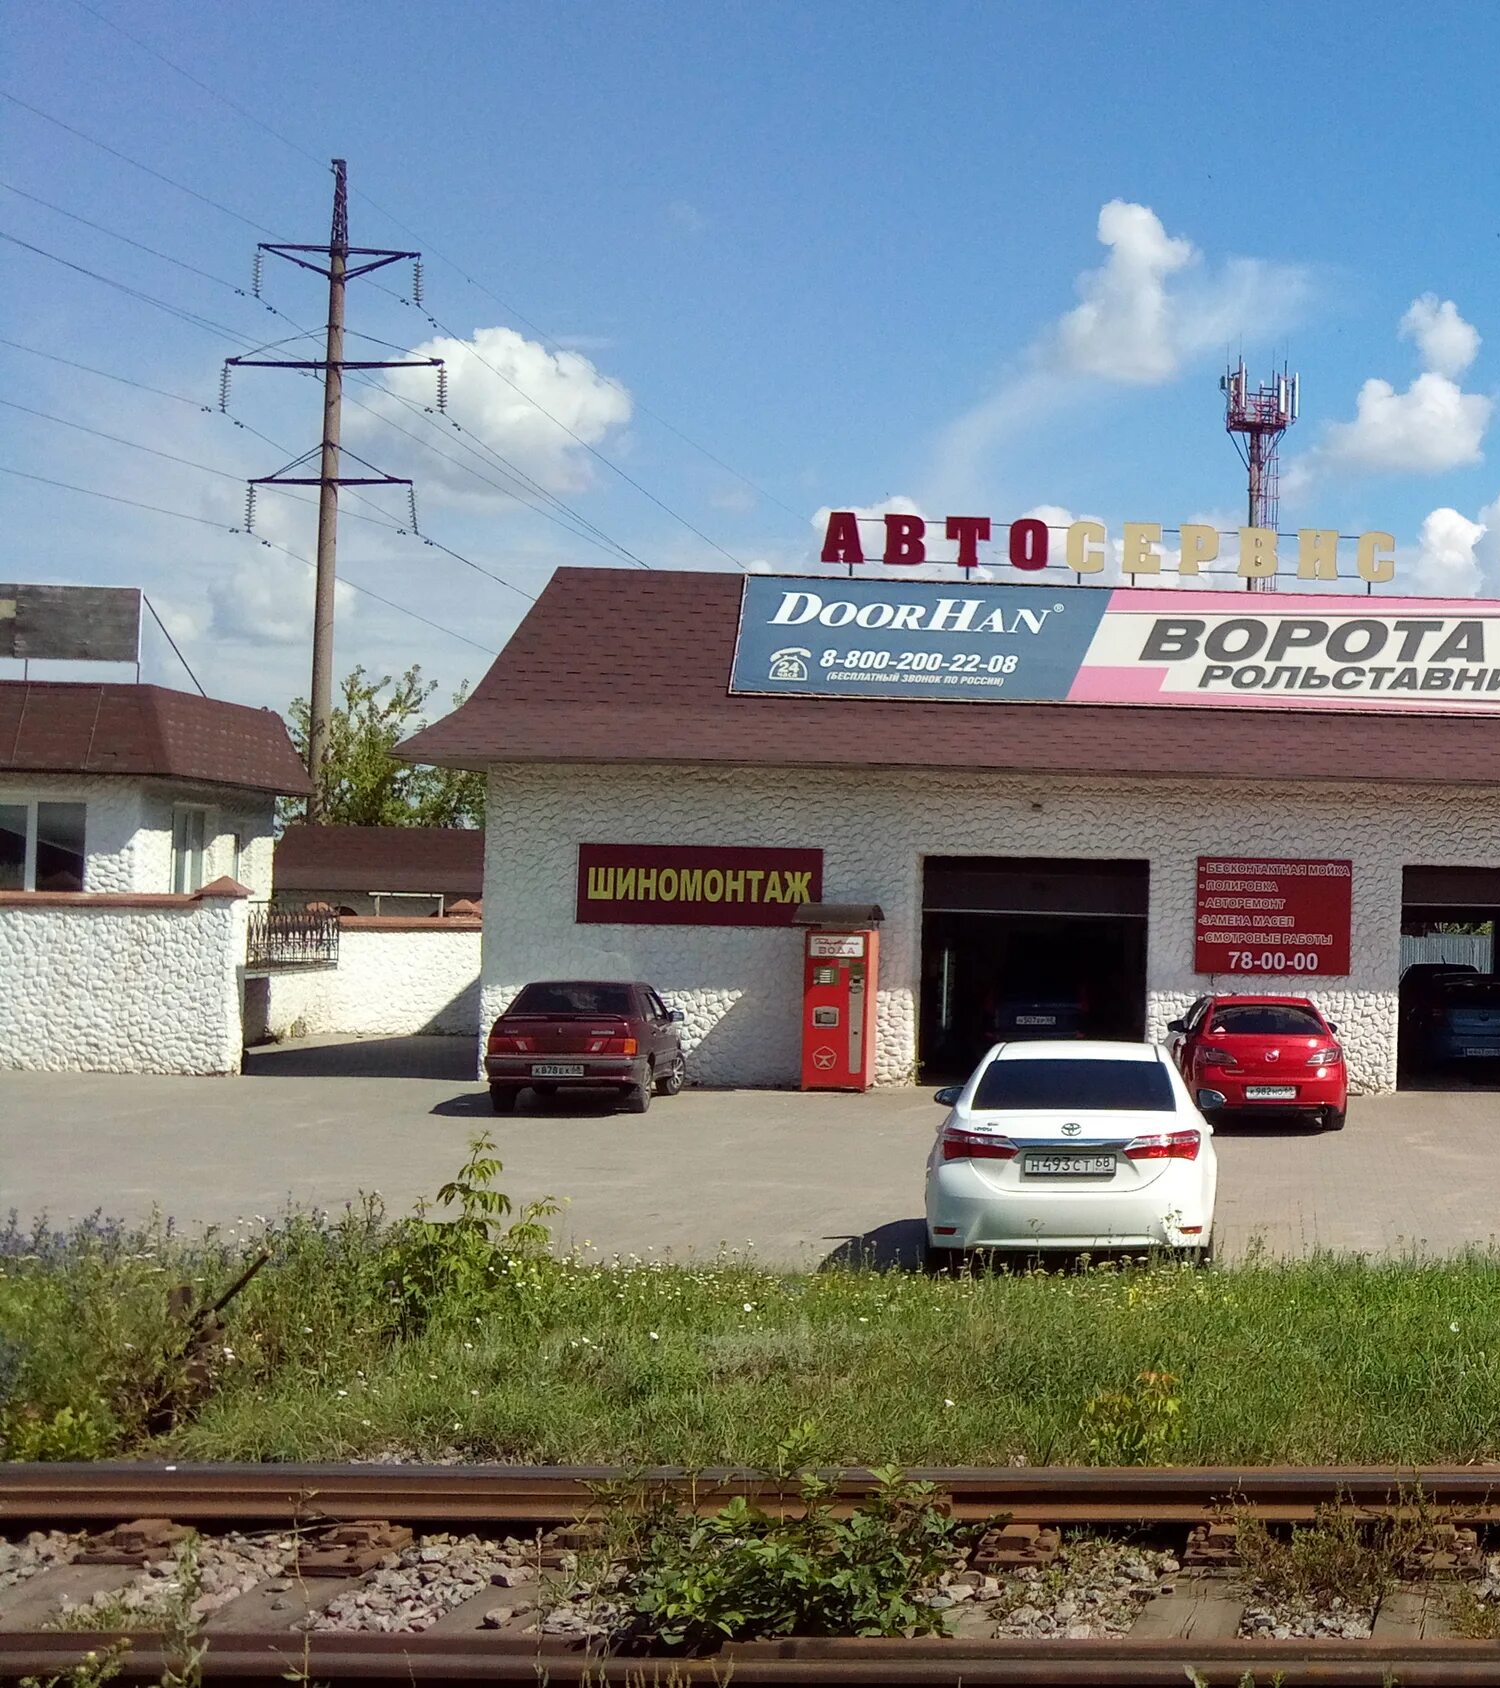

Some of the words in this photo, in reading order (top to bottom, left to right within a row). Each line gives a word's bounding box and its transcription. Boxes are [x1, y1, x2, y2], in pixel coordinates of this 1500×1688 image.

[1138, 618, 1486, 663] ВОРОТА
[778, 661, 800, 673] 24
[819, 649, 1018, 674] 8-800-200-22-08
[826, 671, 899, 683] (БЕСПЛАТНЫЙ
[901, 673, 943, 684] ЗВОНОК
[944, 675, 958, 684] ПО
[959, 676, 1004, 687] РОССИИ)
[1206, 862, 1307, 876] БЕСКОНТАКТНАЯ
[1308, 864, 1350, 877] МОЙКА
[587, 867, 812, 904] ШИНОМОНТАЖ
[1206, 880, 1279, 892] ПОЛИРОВКА
[1204, 897, 1286, 910] АВТОРЕМОНТ
[1252, 915, 1295, 927] МАСЕЛ
[1282, 933, 1333, 946] РАБОТЫ
[818, 946, 855, 954] ВОДА
[1228, 951, 1319, 971] 78-00-00
